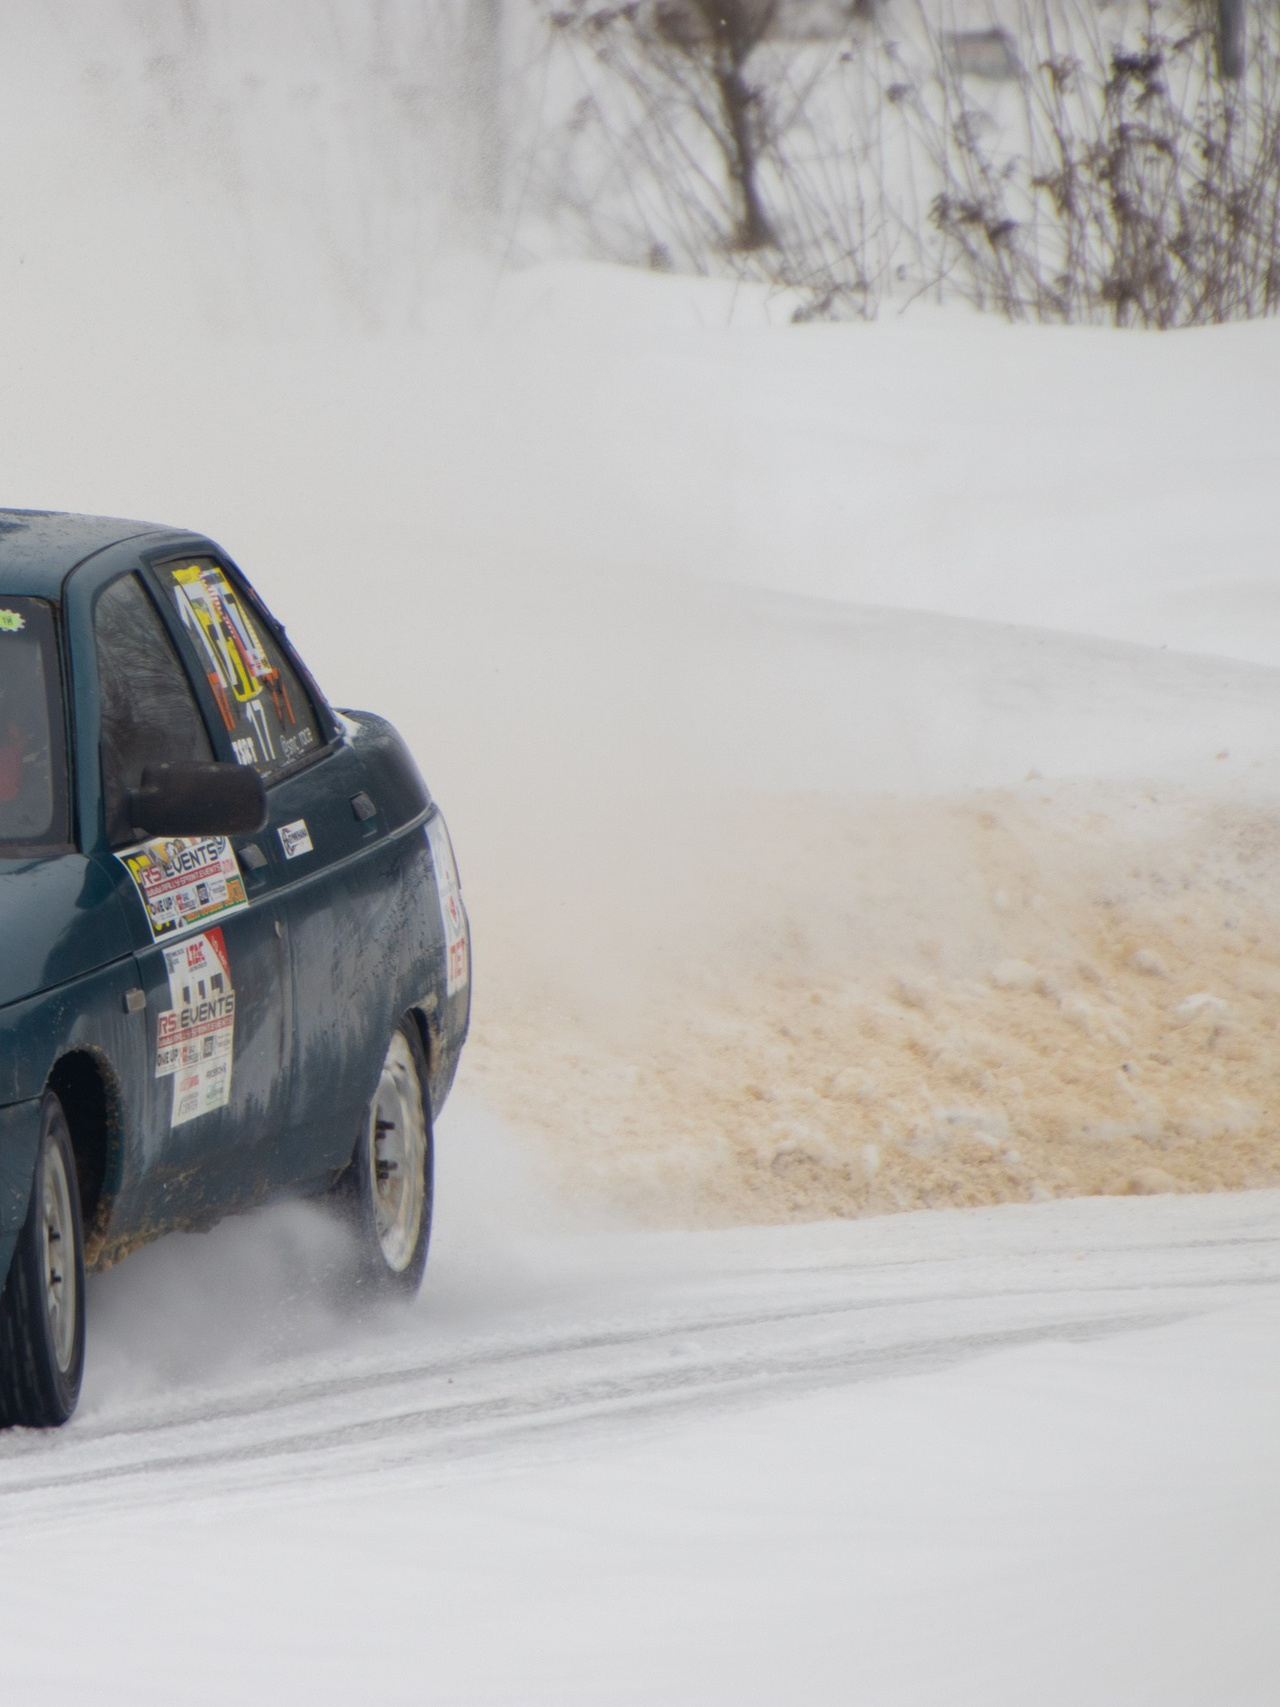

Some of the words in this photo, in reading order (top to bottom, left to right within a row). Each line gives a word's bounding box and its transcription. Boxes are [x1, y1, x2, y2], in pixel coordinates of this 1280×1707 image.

[246, 699, 276, 761] 17
[140, 865, 162, 886] RS
[163, 843, 219, 877] EVENTS
[158, 1013, 176, 1034] RS
[181, 994, 234, 1028] EVENTS
